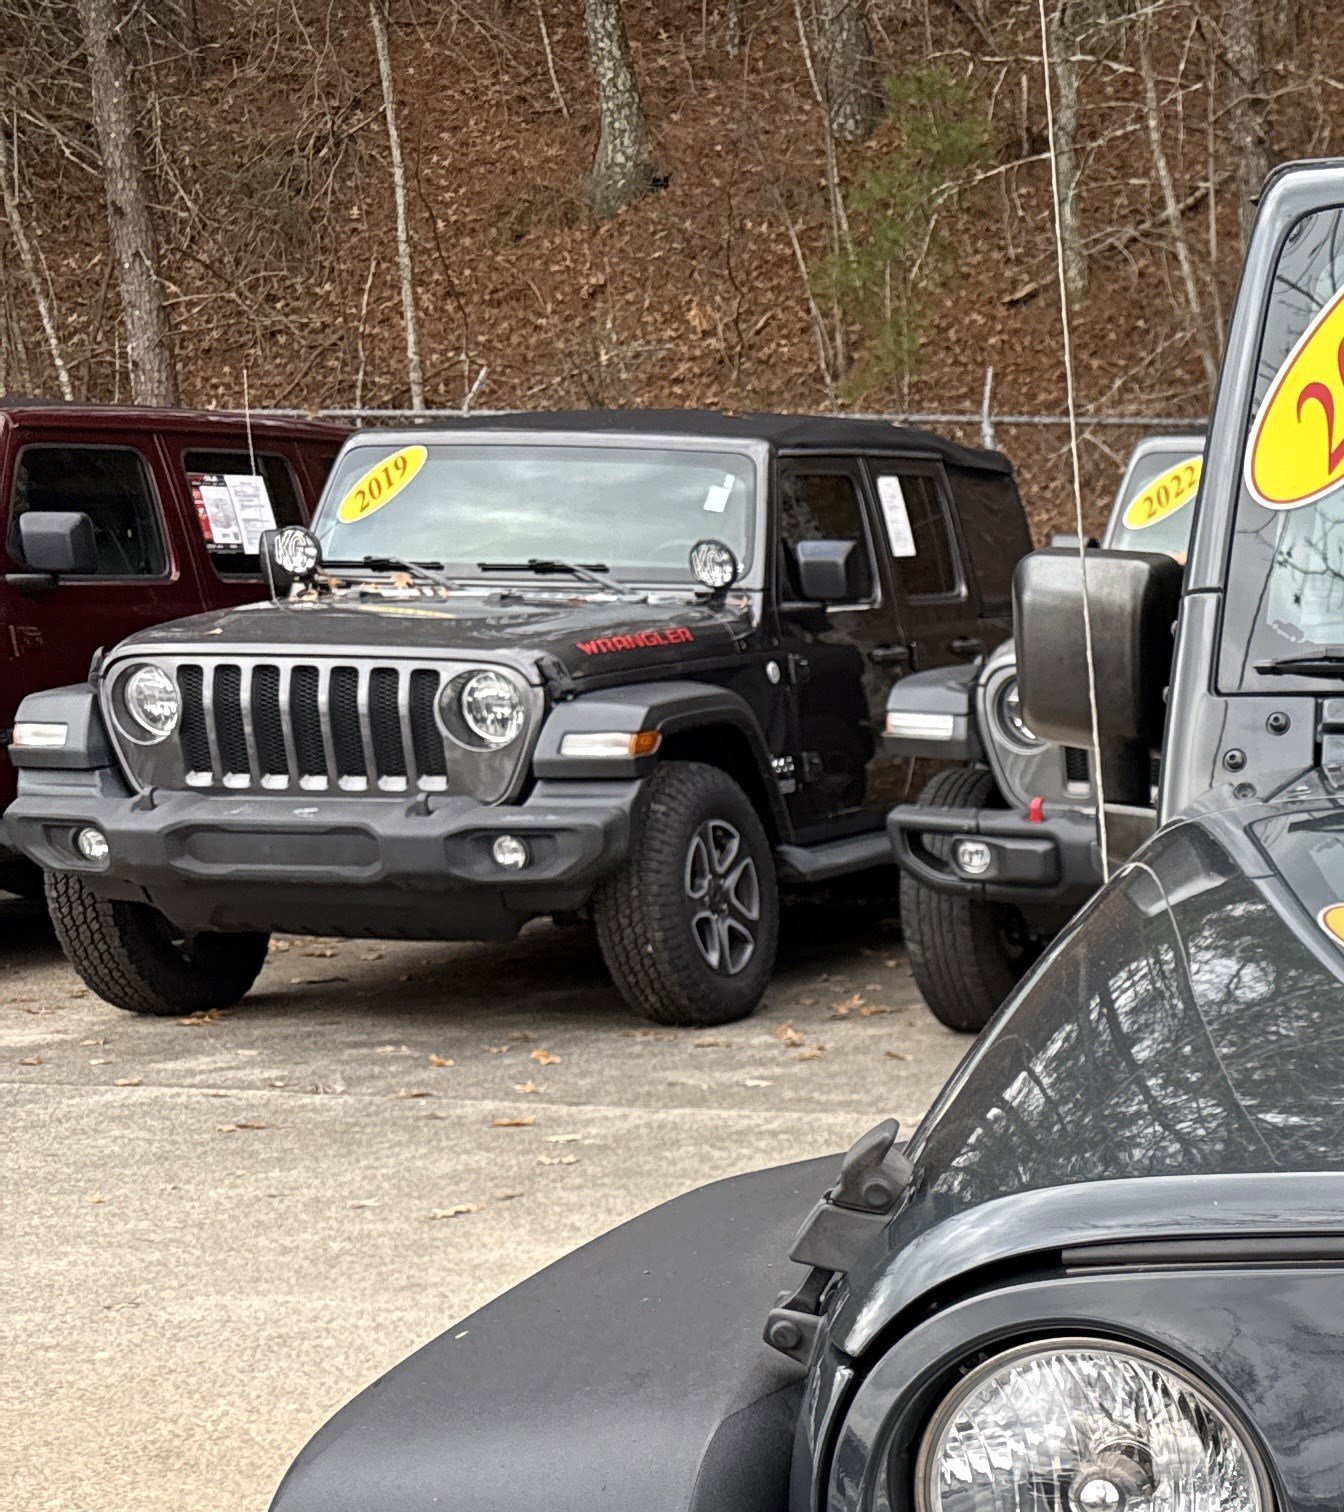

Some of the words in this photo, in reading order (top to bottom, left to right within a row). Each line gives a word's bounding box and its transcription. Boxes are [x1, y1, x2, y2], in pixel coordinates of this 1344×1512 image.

[354, 455, 408, 512] 2019
[1143, 465, 1197, 519] 2022
[575, 626, 694, 655] WRANGLER
